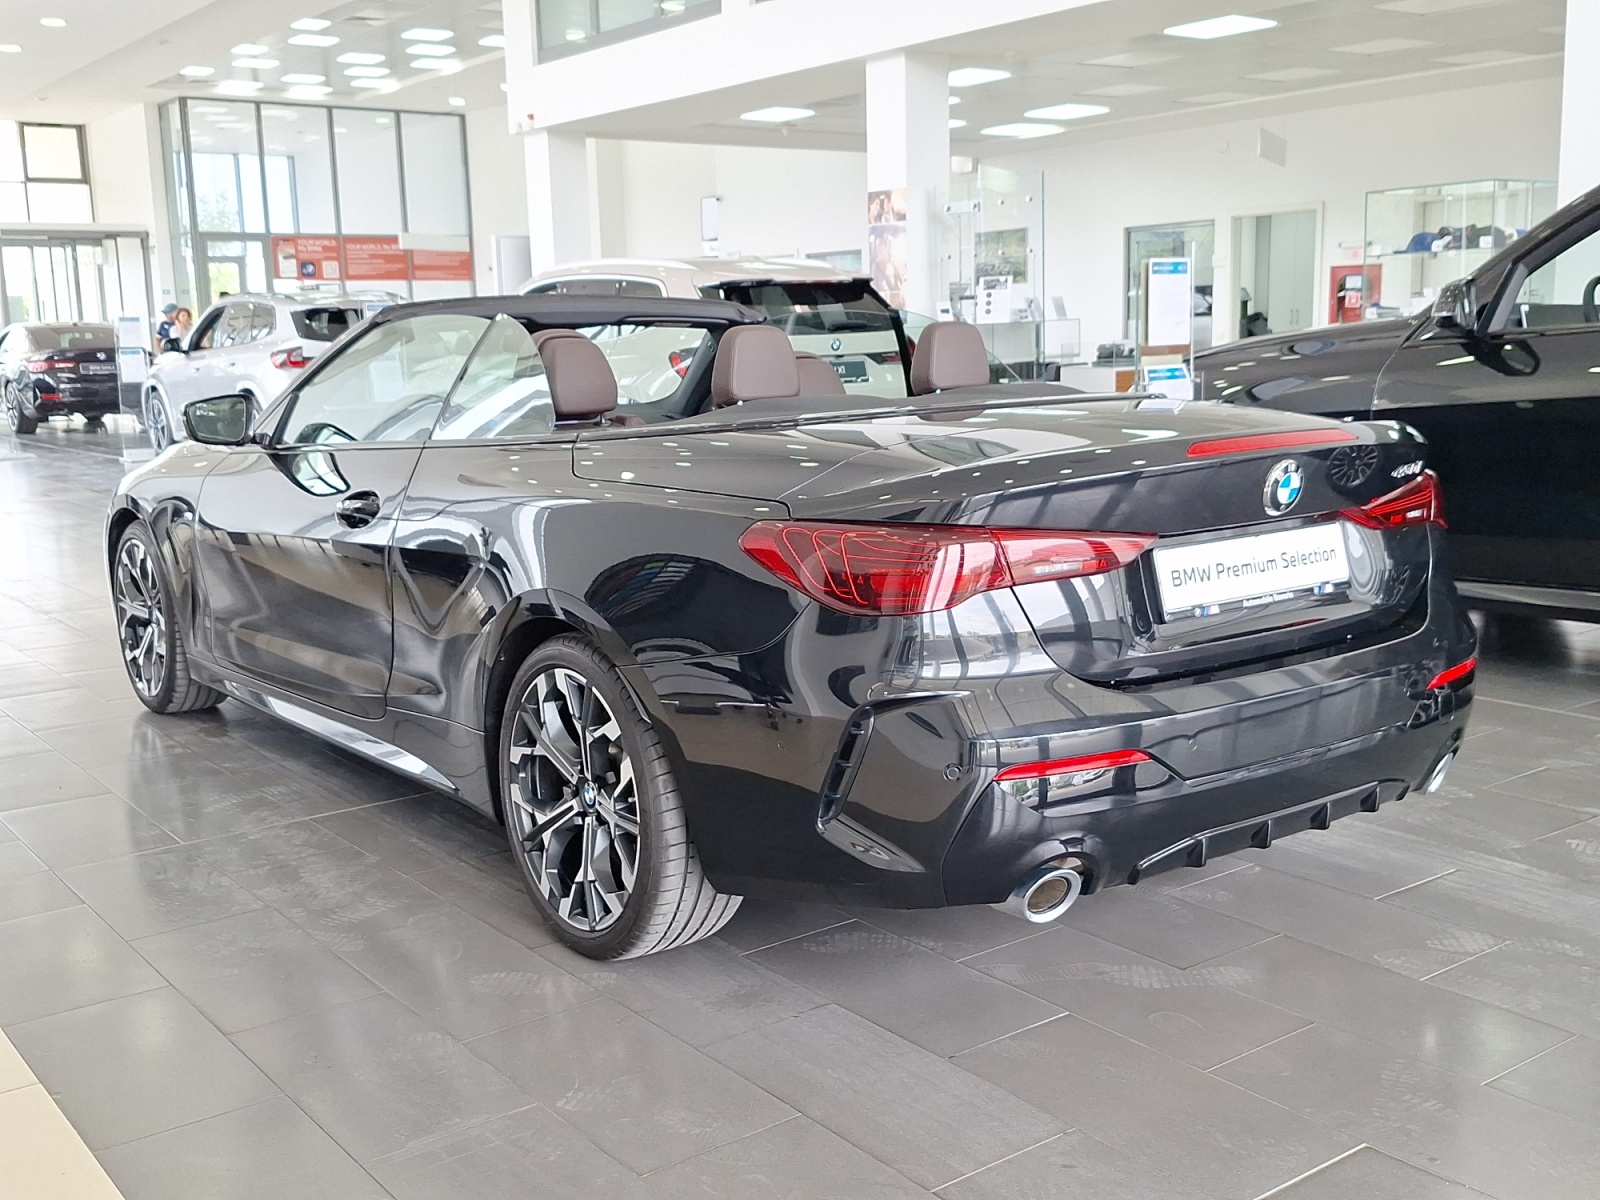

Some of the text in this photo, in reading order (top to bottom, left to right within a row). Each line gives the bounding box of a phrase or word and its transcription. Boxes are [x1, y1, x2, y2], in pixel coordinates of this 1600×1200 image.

[1171, 546, 1337, 587] BMW Premium Selection
